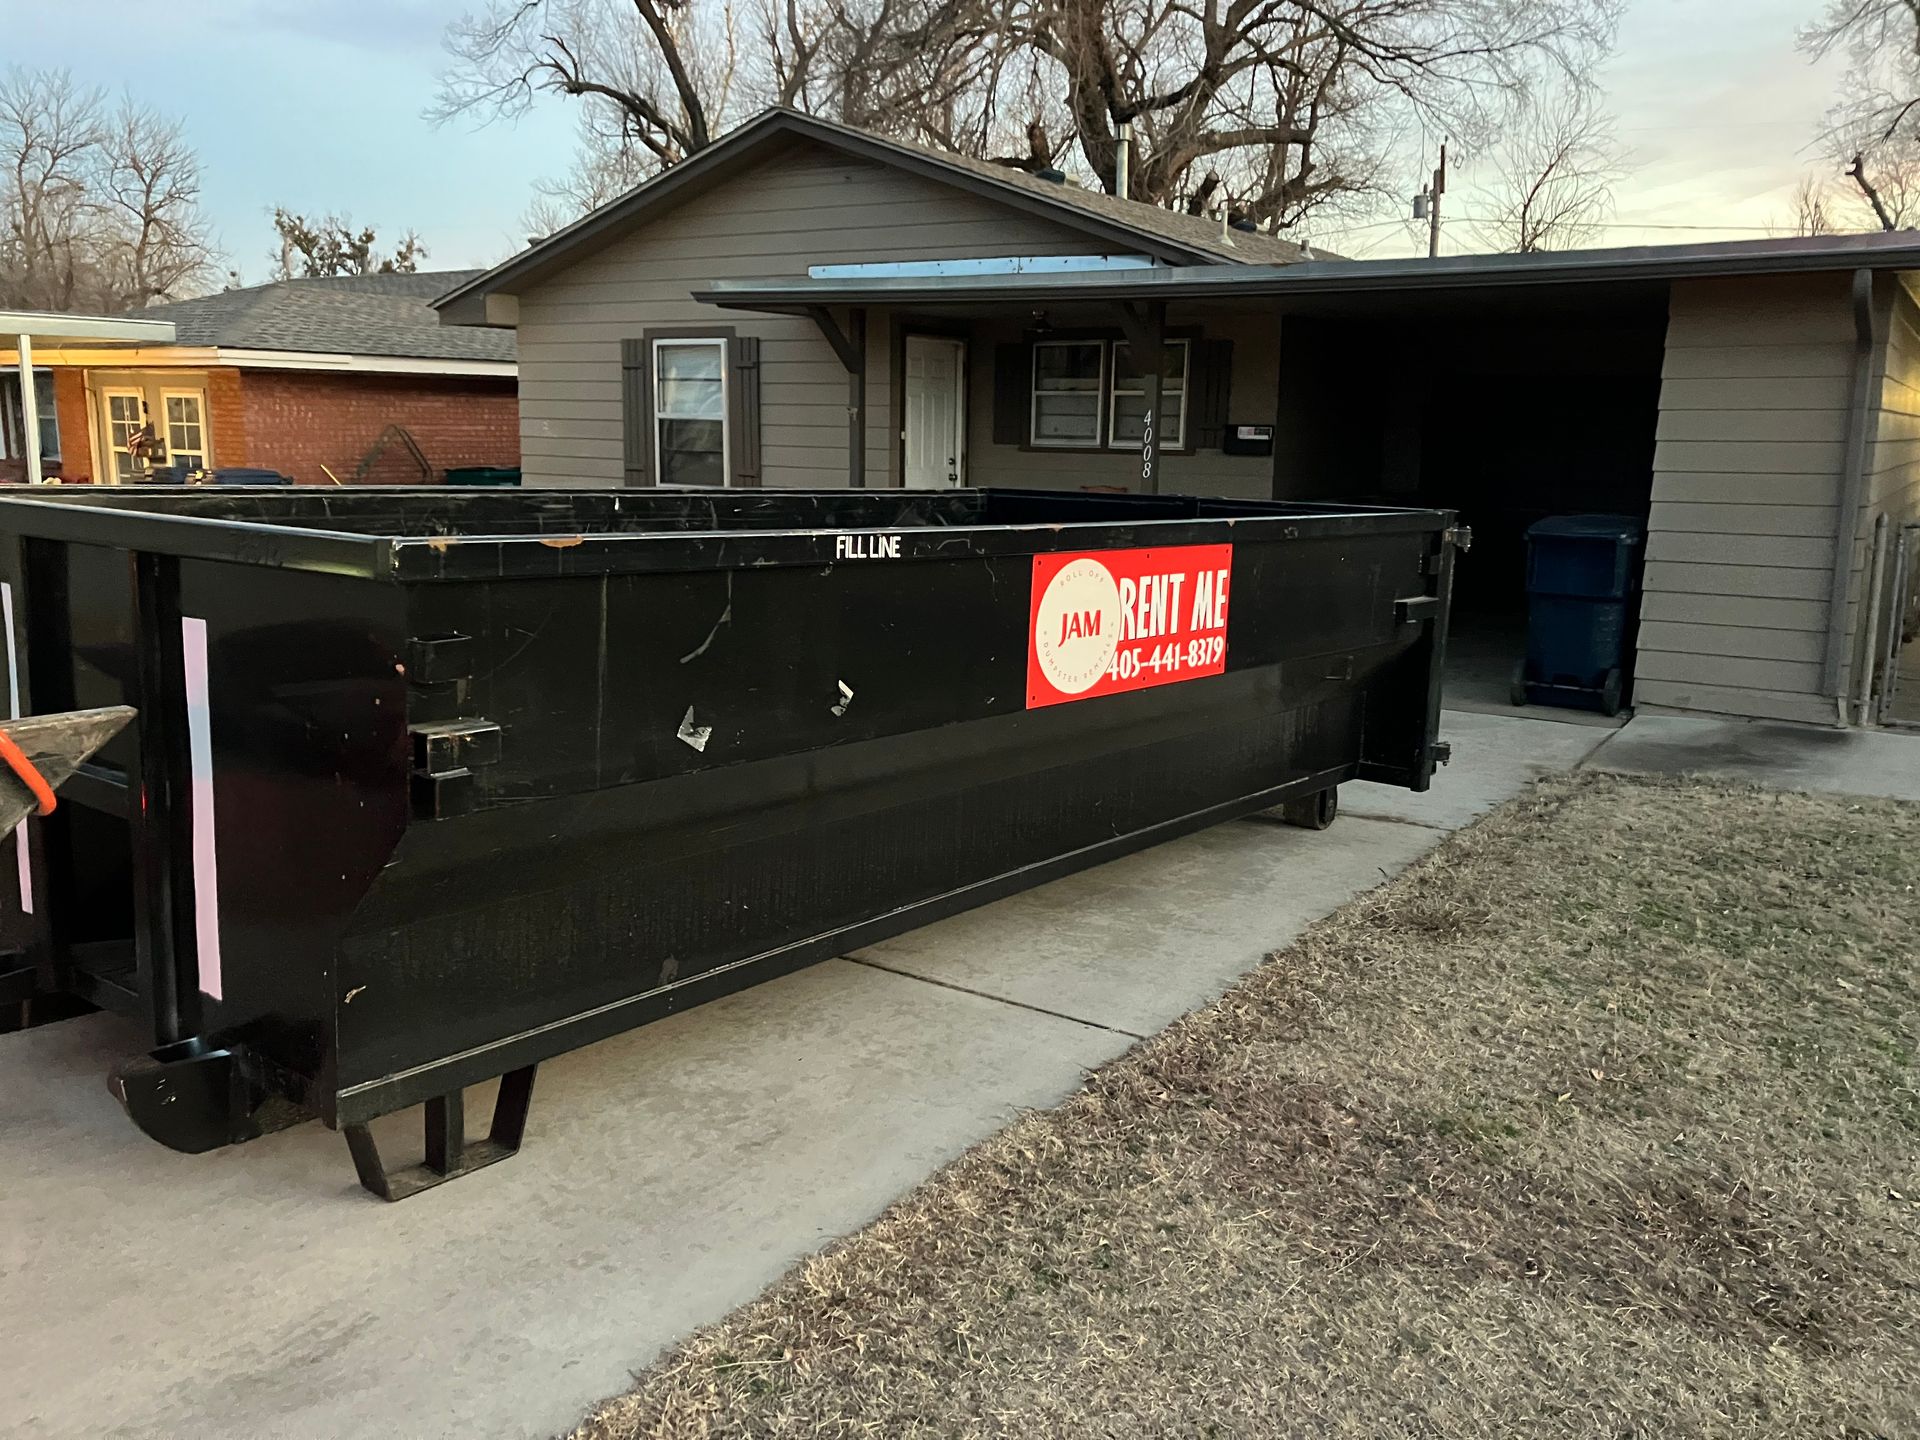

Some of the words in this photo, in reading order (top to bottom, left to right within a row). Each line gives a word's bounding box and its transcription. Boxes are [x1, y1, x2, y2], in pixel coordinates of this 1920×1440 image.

[1142, 409, 1152, 478] 4008
[836, 535, 867, 559] FILL
[869, 535, 901, 558] LINE
[1118, 572, 1185, 641] RENT
[1190, 569, 1228, 631] ME
[1057, 609, 1102, 648] JAM
[1105, 636, 1224, 681] 405-441-8379
